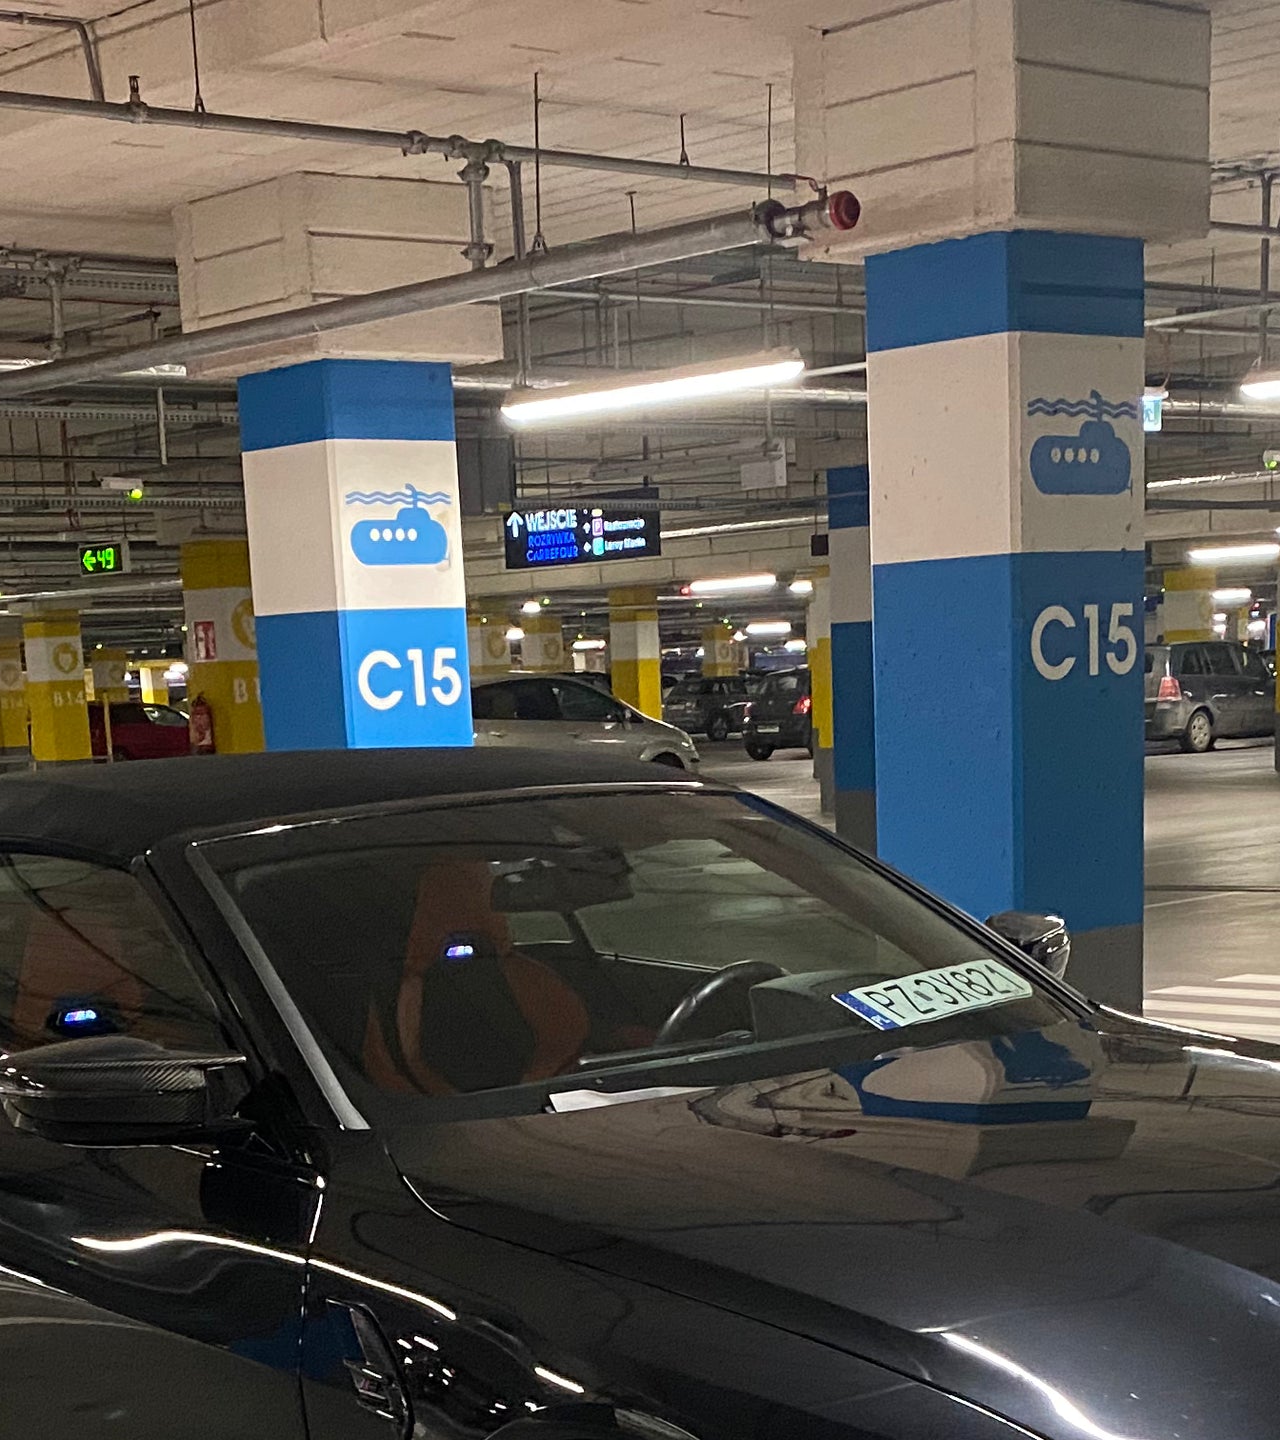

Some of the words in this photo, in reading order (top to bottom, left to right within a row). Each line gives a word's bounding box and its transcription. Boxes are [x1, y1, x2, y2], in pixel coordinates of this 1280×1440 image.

[96, 547, 114, 569] 49
[1031, 602, 1137, 681] C15
[358, 647, 462, 711] C15
[863, 984, 937, 1020] PZ
